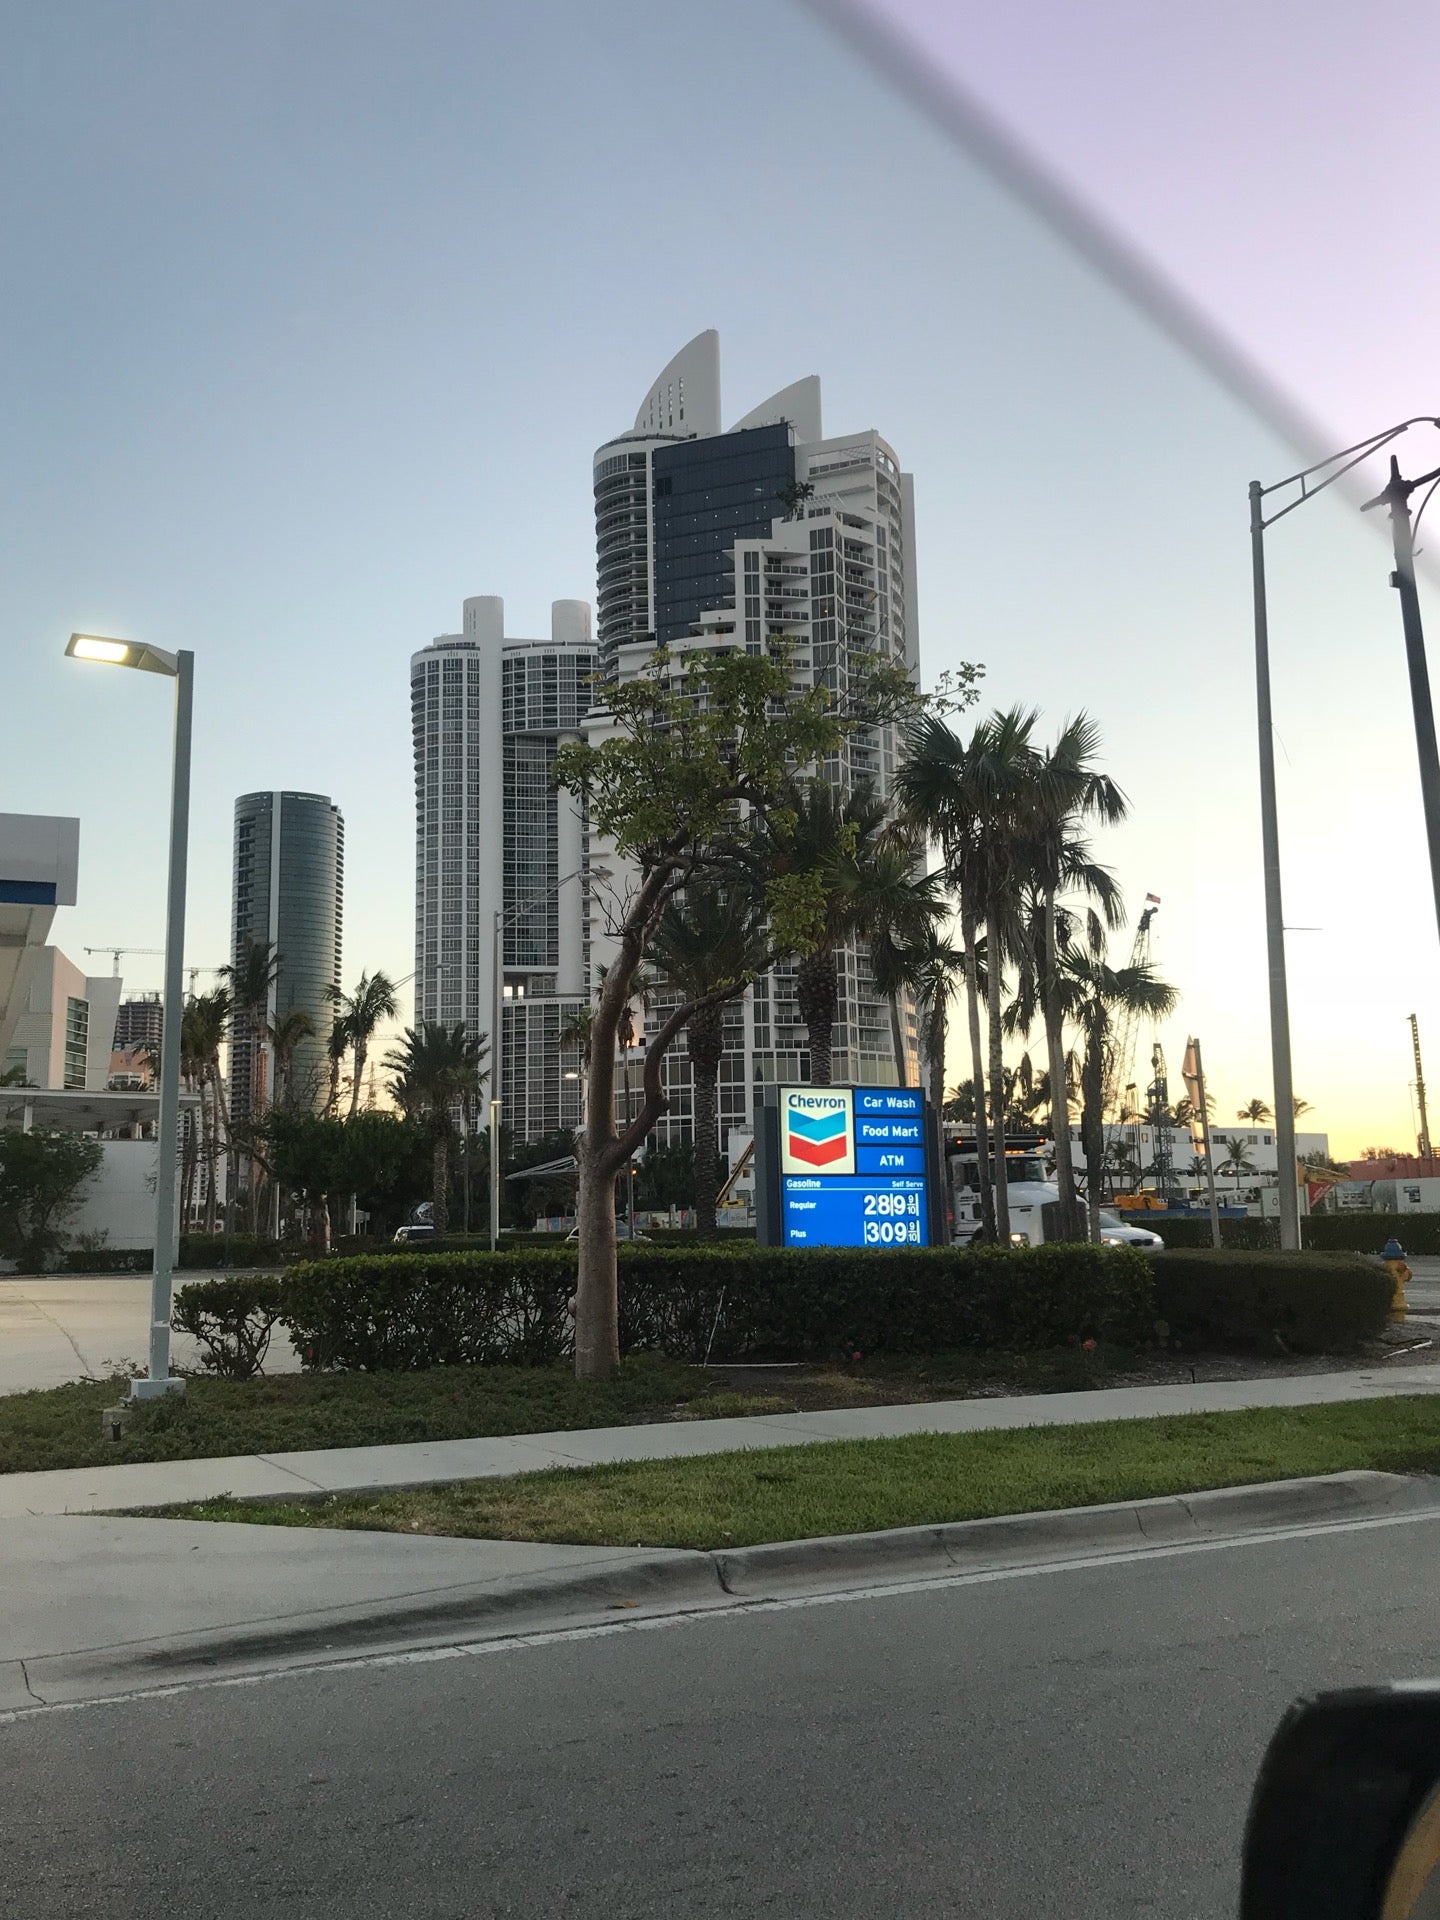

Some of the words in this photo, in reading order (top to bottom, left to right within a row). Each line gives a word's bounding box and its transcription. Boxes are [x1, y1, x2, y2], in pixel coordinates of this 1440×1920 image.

[788, 1094, 846, 1109] Chevron
[863, 1097, 883, 1108] Car
[886, 1097, 916, 1108] Wash
[862, 1125, 889, 1137] Food
[892, 1125, 918, 1137] Mart
[879, 1155, 904, 1166] ATM
[786, 1179, 821, 1188] Gasoline
[789, 1201, 817, 1210] Regular
[790, 1230, 807, 1238] Plus
